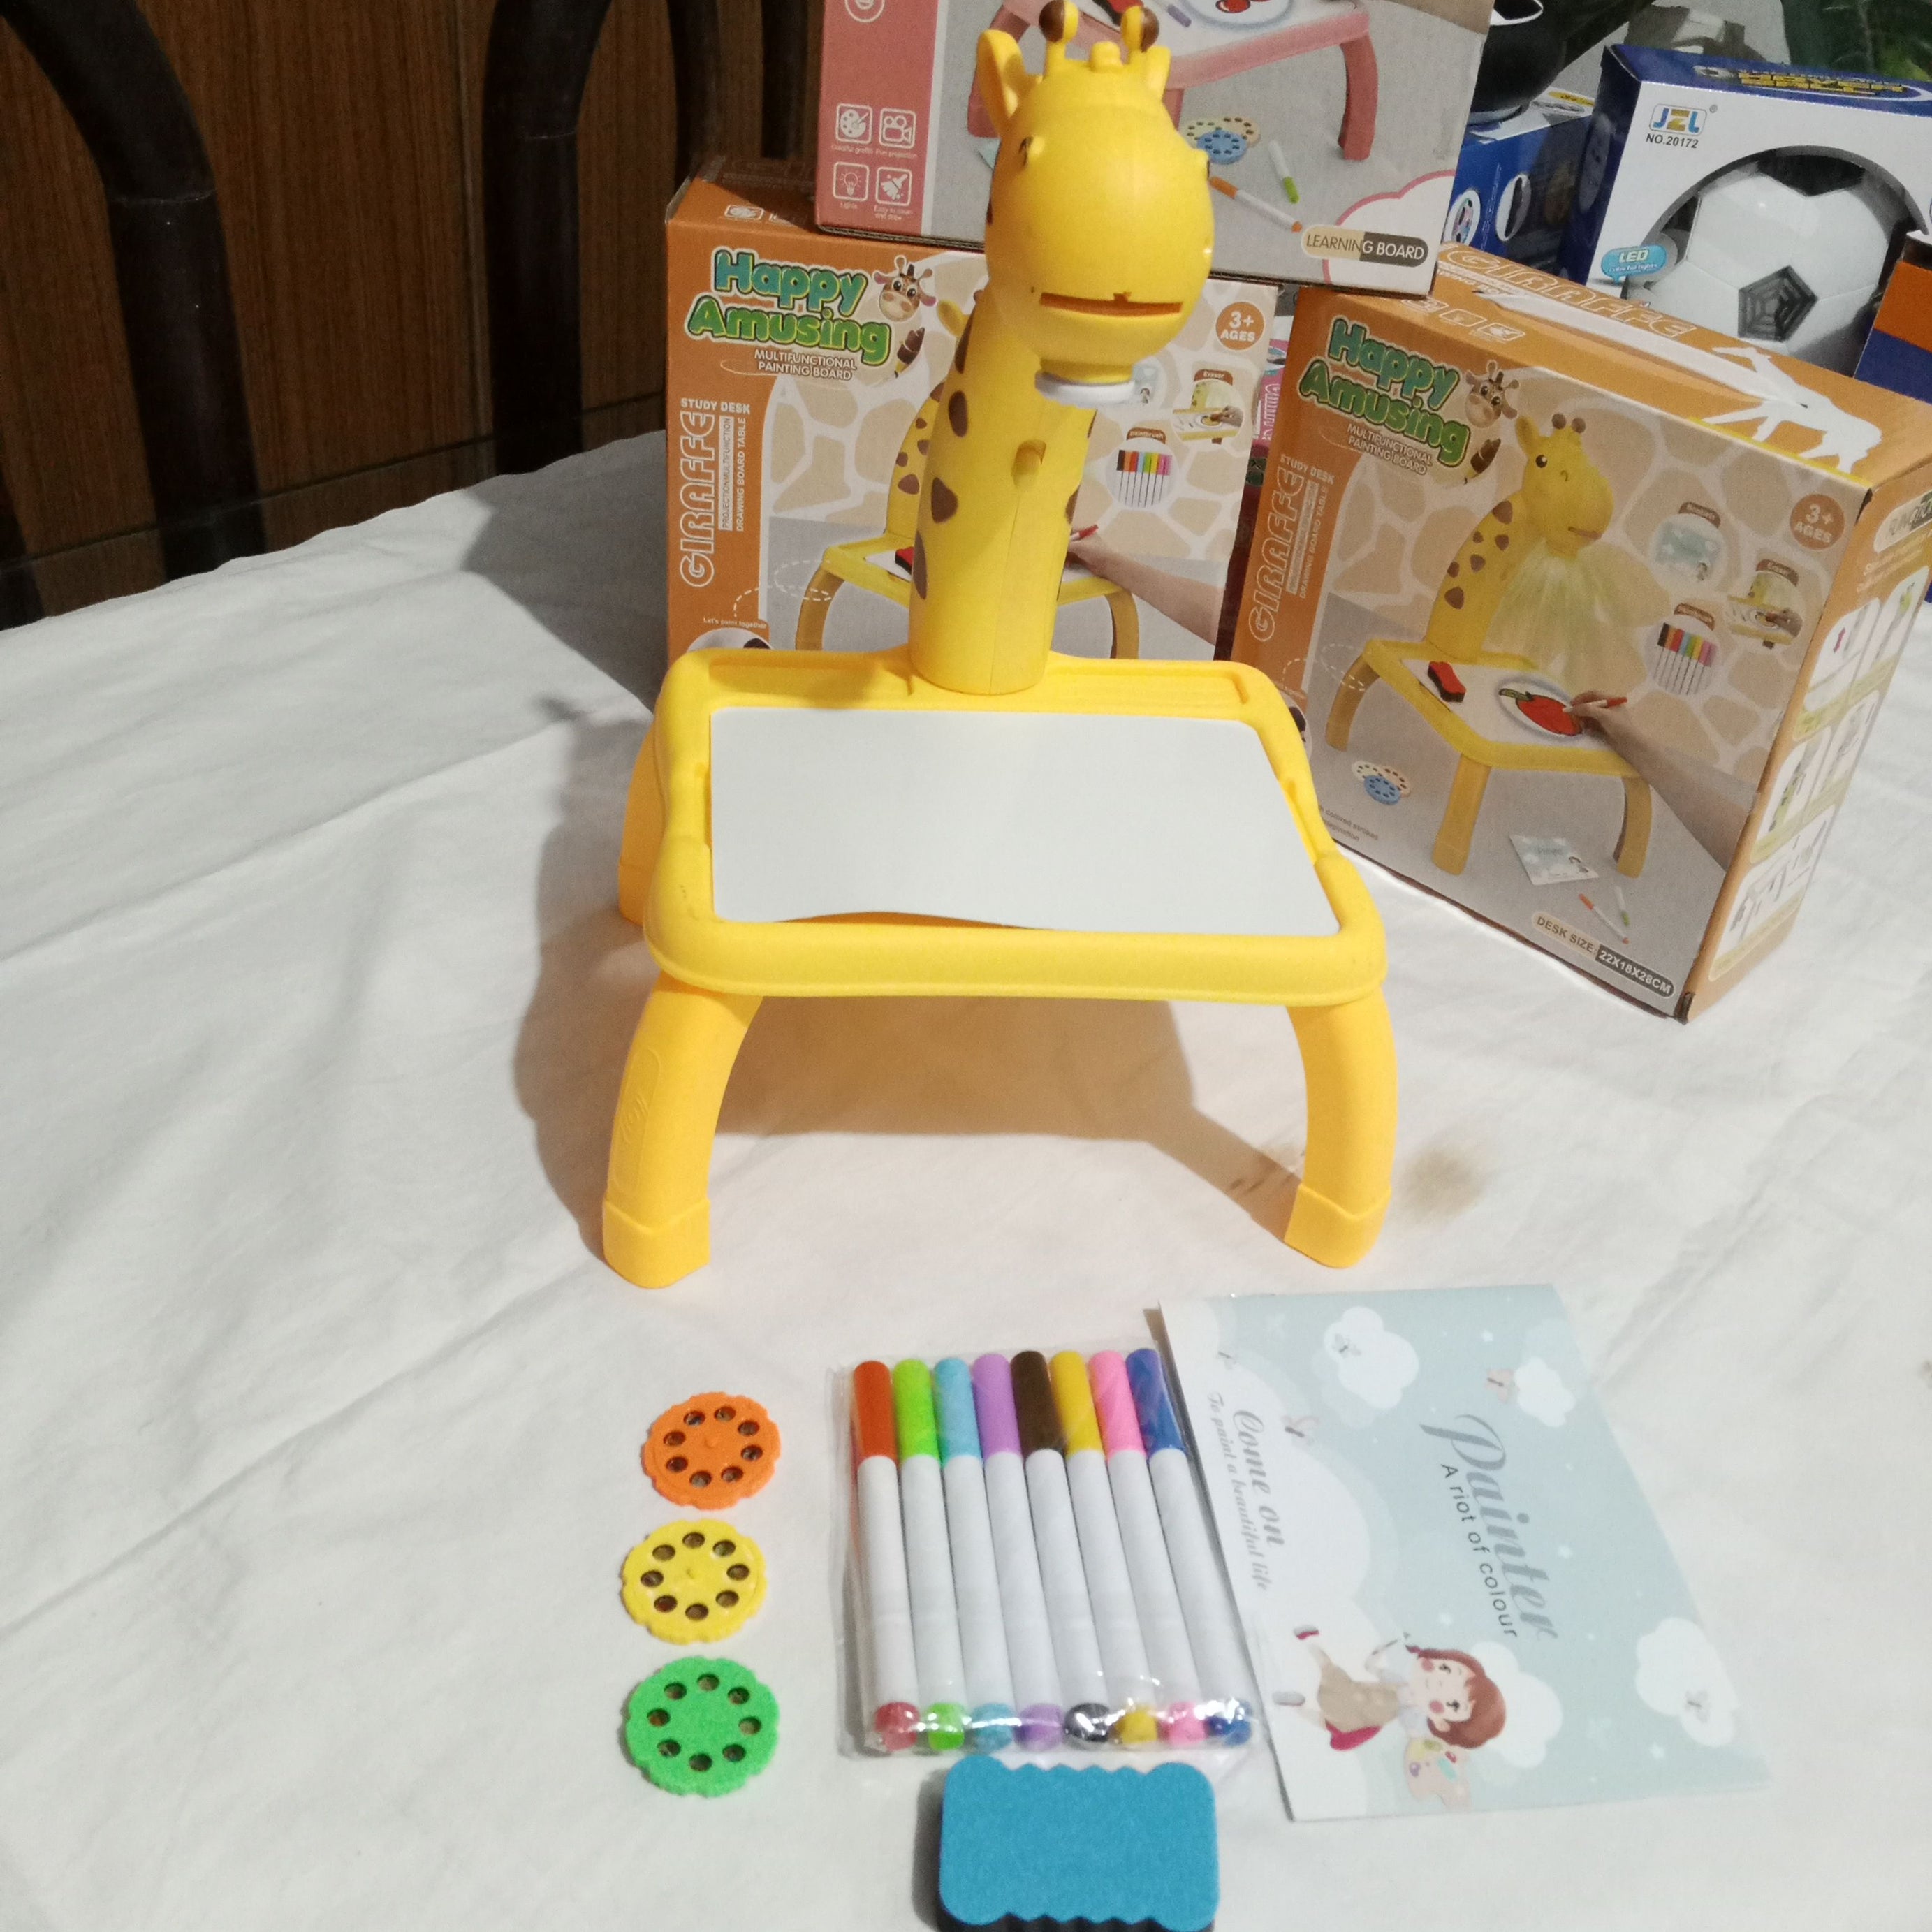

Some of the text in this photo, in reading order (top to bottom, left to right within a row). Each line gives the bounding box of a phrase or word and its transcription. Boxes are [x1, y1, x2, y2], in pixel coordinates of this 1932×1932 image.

[1645, 133, 1699, 149] NO.20172
[1653, 108, 1700, 133] JZL
[1306, 233, 1425, 261] LEARNING BOARD
[1618, 249, 1649, 263] LED
[713, 249, 869, 316] Happy
[688, 294, 893, 365] Amusing
[1220, 329, 1256, 342] AGES
[1229, 311, 1254, 329] 3+
[754, 349, 857, 371] MULTIFUNCTIONAL
[758, 360, 853, 381] PAINTING BOARD
[1329, 318, 1460, 411] Happy
[680, 397, 751, 416] STUDY DESK
[1299, 358, 1472, 468] Amusing
[1347, 423, 1433, 467] MULTIFUNCTIONAL
[1348, 435, 1427, 476] PAINTING BOARD
[736, 417, 747, 532] DRAWING BOARD TABLE
[680, 410, 715, 588] GIRAFFE
[1806, 503, 1834, 525] 3+
[1794, 520, 1834, 543] AGES
[1247, 466, 1305, 643] GIRAFFE
[1536, 916, 1569, 939] DESK
[1597, 950, 1672, 995] 22X18X28CM
[1207, 1391, 1273, 1592] To paint a beautiful life
[1232, 1409, 1285, 1546] Come on
[1419, 1414, 1559, 1640] Painter
[1440, 1463, 1518, 1638] A riot of colour
